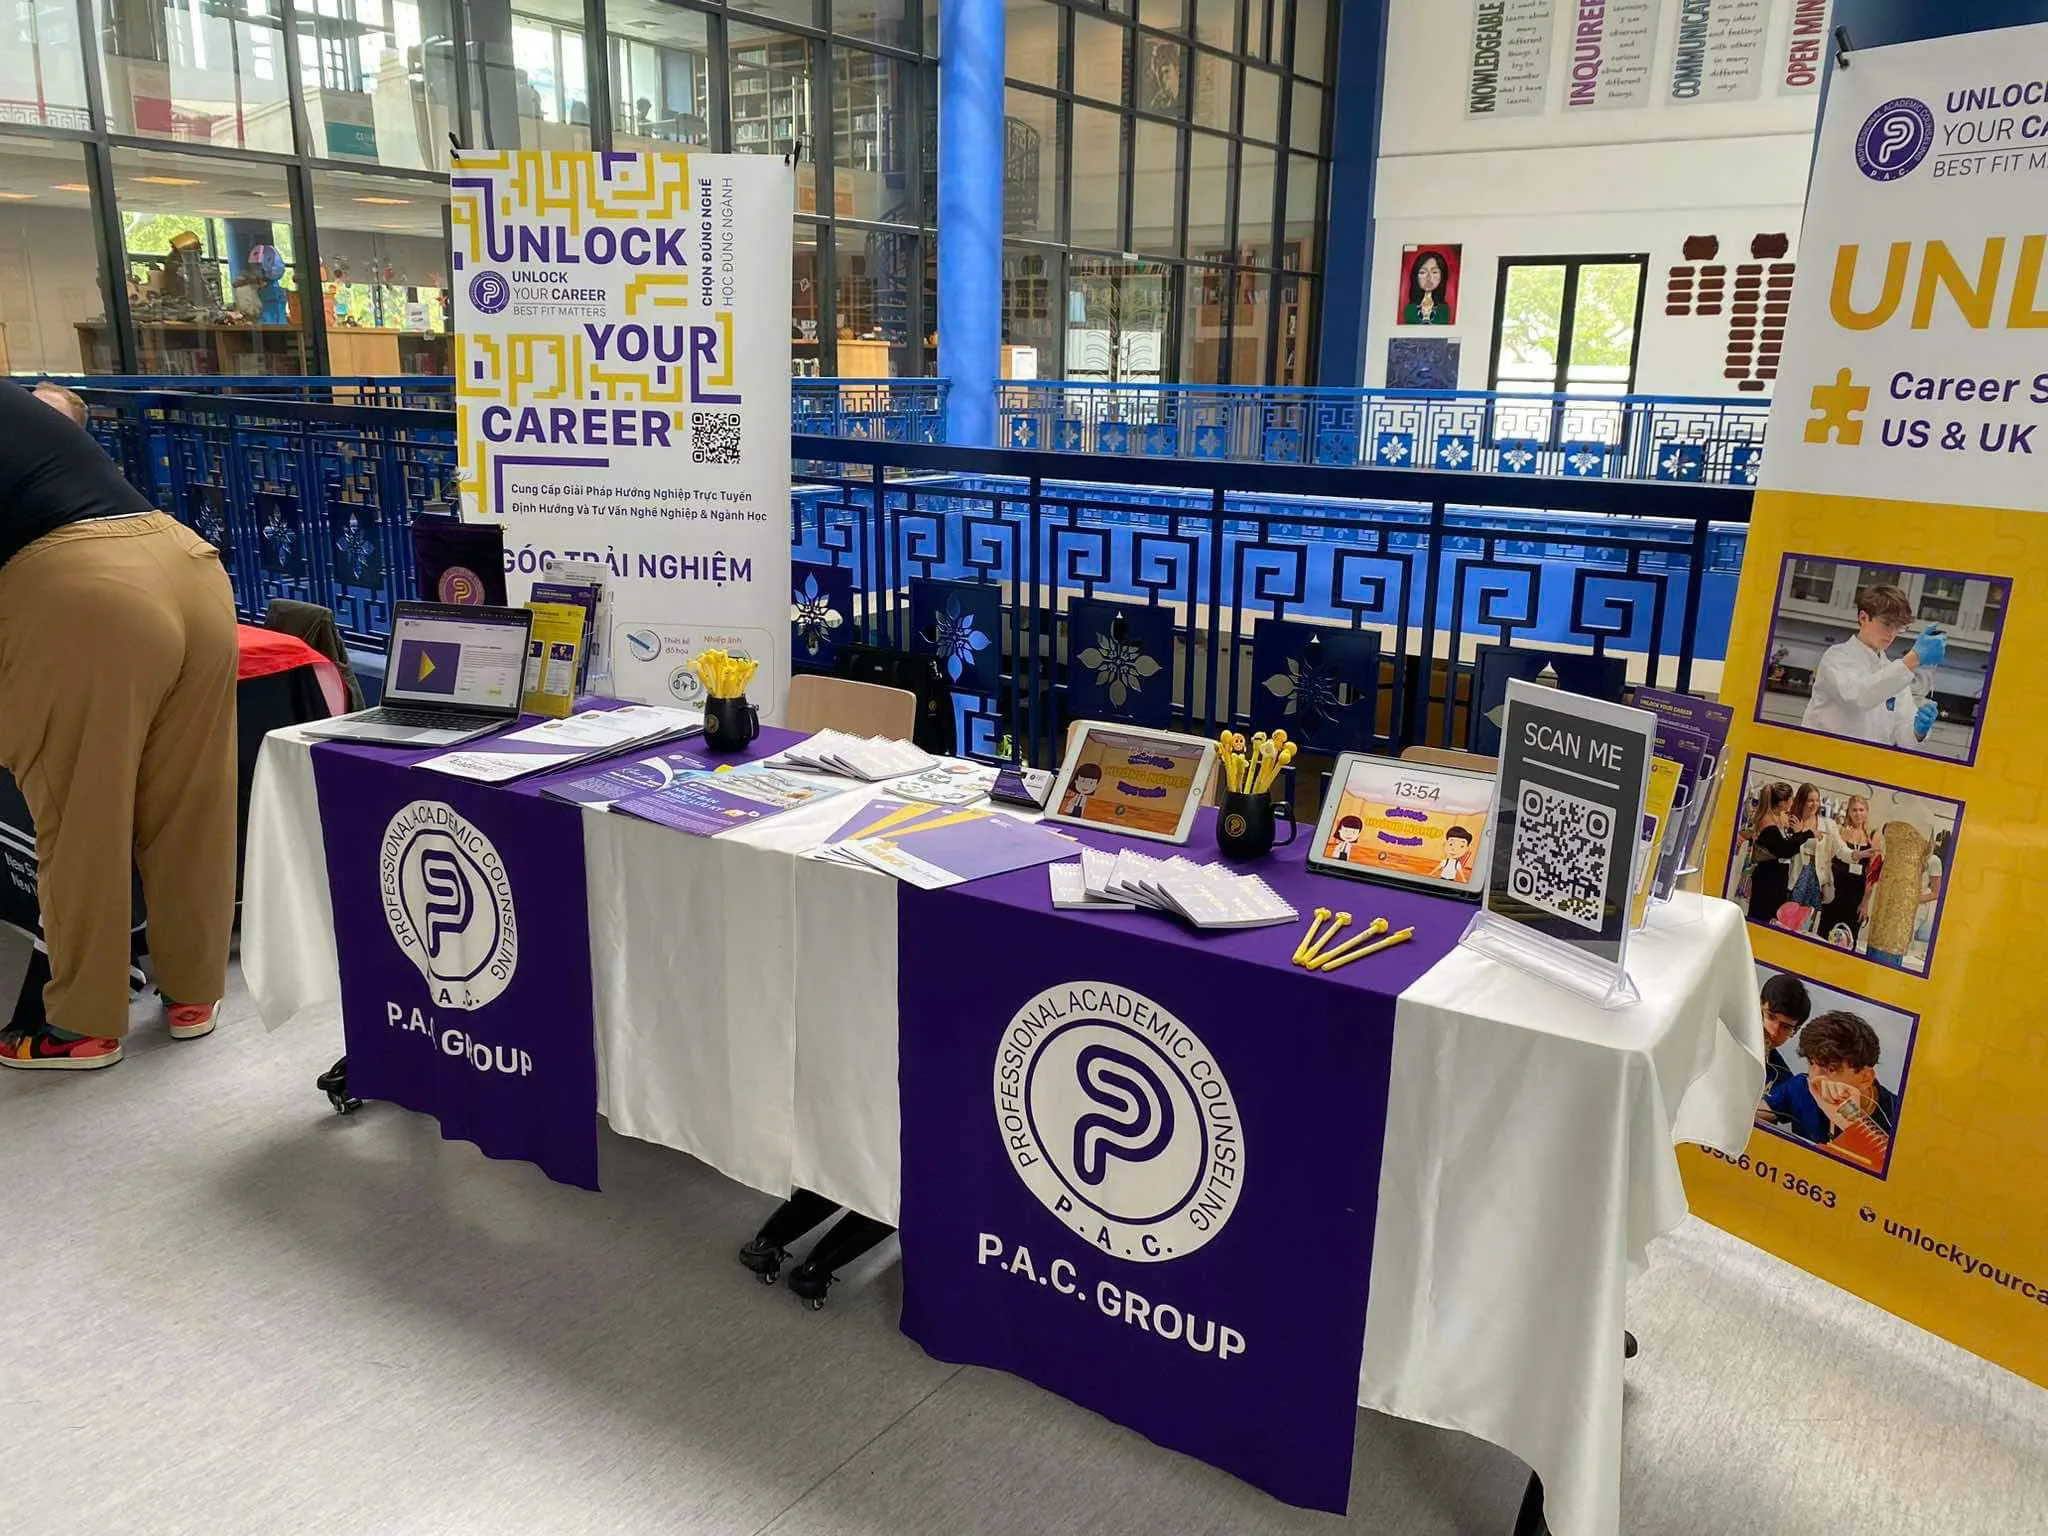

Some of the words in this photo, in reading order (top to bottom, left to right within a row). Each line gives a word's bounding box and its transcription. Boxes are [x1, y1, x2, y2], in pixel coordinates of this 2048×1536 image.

[1470, 2, 1504, 113] KNOWLEDGEABLE
[1786, 39, 1820, 86] OPEN
[1946, 81, 2048, 113] UNLOC
[1944, 118, 2014, 146] YOUR
[1933, 157, 1987, 177] BEST
[1991, 153, 2024, 173] FIT
[2029, 152, 2048, 171] M
[486, 224, 688, 267] UNLOCK
[512, 271, 568, 283] UNLOCK
[513, 287, 548, 300] YOUR
[551, 288, 606, 301] CAREER
[514, 306, 538, 316] BEST
[541, 306, 557, 316] FIT
[559, 307, 606, 318] MATTERS
[584, 324, 719, 364] YOUR
[1890, 371, 2021, 402] Career
[481, 405, 672, 448] CAREER
[1881, 418, 1931, 448] US
[1940, 422, 1966, 451] &
[1980, 423, 2038, 454] UK
[511, 484, 538, 496] Cung
[541, 483, 561, 496] Cấp
[563, 484, 583, 496] Giải
[586, 485, 613, 498] Pháp
[615, 486, 650, 500] Hướng
[653, 488, 691, 501] Nghiệp
[693, 490, 717, 502] Trực
[720, 489, 752, 502] Tuyến
[512, 502, 536, 515] Định
[539, 503, 574, 517] Hướng
[577, 503, 589, 515] Và
[592, 505, 605, 515] Tư
[608, 504, 627, 516] Vấn
[660, 507, 698, 520] Nghiệp
[700, 509, 707, 519] &
[710, 509, 744, 522] Ngành
[747, 511, 767, 524] Học
[639, 550, 752, 587] NGHIỆM
[1523, 721, 1582, 759] SCAN
[1588, 739, 1624, 771] ME
[1394, 782, 1440, 801] 13:54
[383, 812, 417, 948] PROFESSIONAL
[412, 805, 483, 854] ACADEMIC
[482, 852, 515, 981] COUNSELING
[1001, 997, 1066, 1168] PROFESSIONAL
[1069, 988, 1194, 1060] ACADEMIC
[1189, 1060, 1237, 1231] COUNSELING
[1782, 1172, 1837, 1209] 3663
[1883, 1217, 2048, 1306] unlockyourca
[978, 1232, 1086, 1302] P.A.C.
[1096, 1280, 1247, 1361] GROUP
